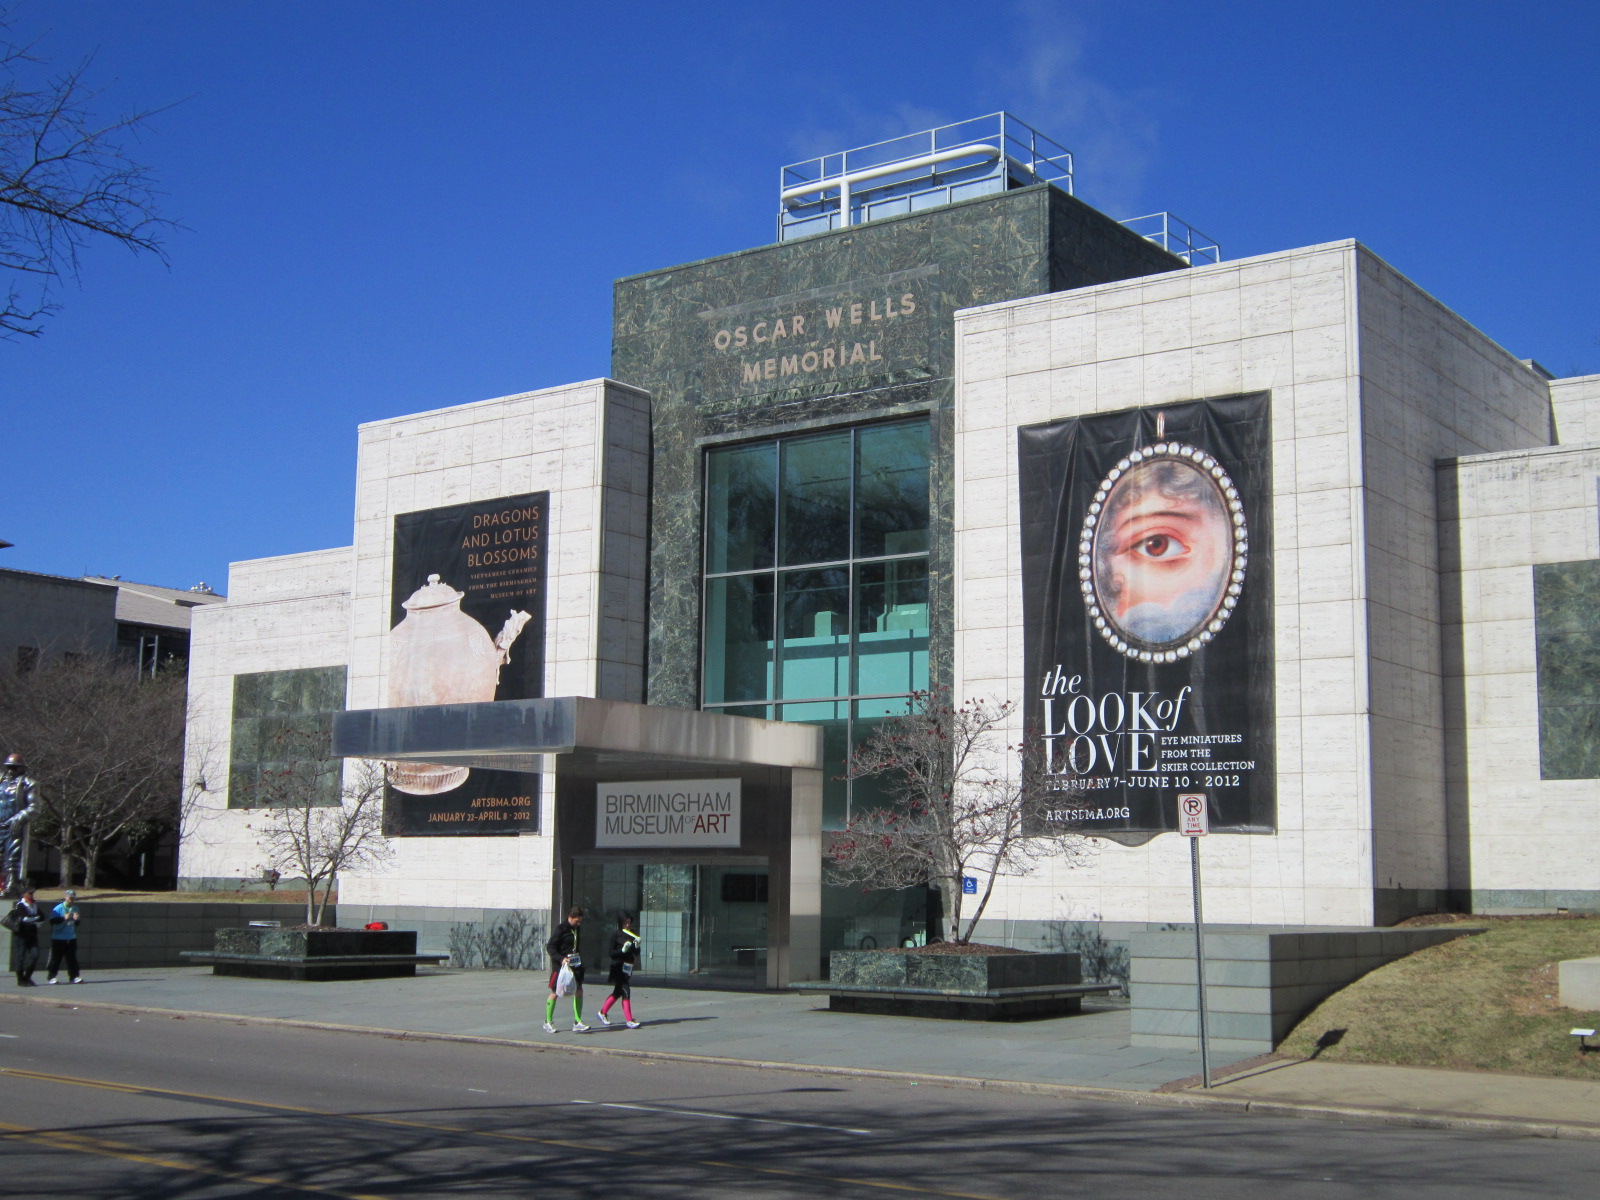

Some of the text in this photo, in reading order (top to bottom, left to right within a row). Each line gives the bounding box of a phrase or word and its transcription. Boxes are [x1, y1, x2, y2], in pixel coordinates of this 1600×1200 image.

[714, 293, 916, 350] OSCAR WELLS
[743, 340, 882, 383] MEMORIAL
[473, 506, 539, 529] DRAGONS
[462, 525, 539, 549] AND LOTUS
[467, 545, 538, 567] BLOSSOMS
[1041, 664, 1082, 696] the
[1040, 686, 1192, 737] LOOK of
[1161, 734, 1242, 746] EYE MINIATURES
[1041, 732, 1158, 776] LOVE
[1161, 748, 1211, 759] FROM THE
[1161, 761, 1255, 772] SKIER COLLECTION
[1174, 776, 1190, 788] 10
[1205, 775, 1240, 787] 2012
[470, 796, 531, 808] ARTSBMA.ORG
[605, 792, 731, 814] BIRMINGHAM
[428, 812, 466, 823] JANUARY
[513, 812, 530, 820] 2012
[605, 814, 731, 835] MUSEUM OF ART
